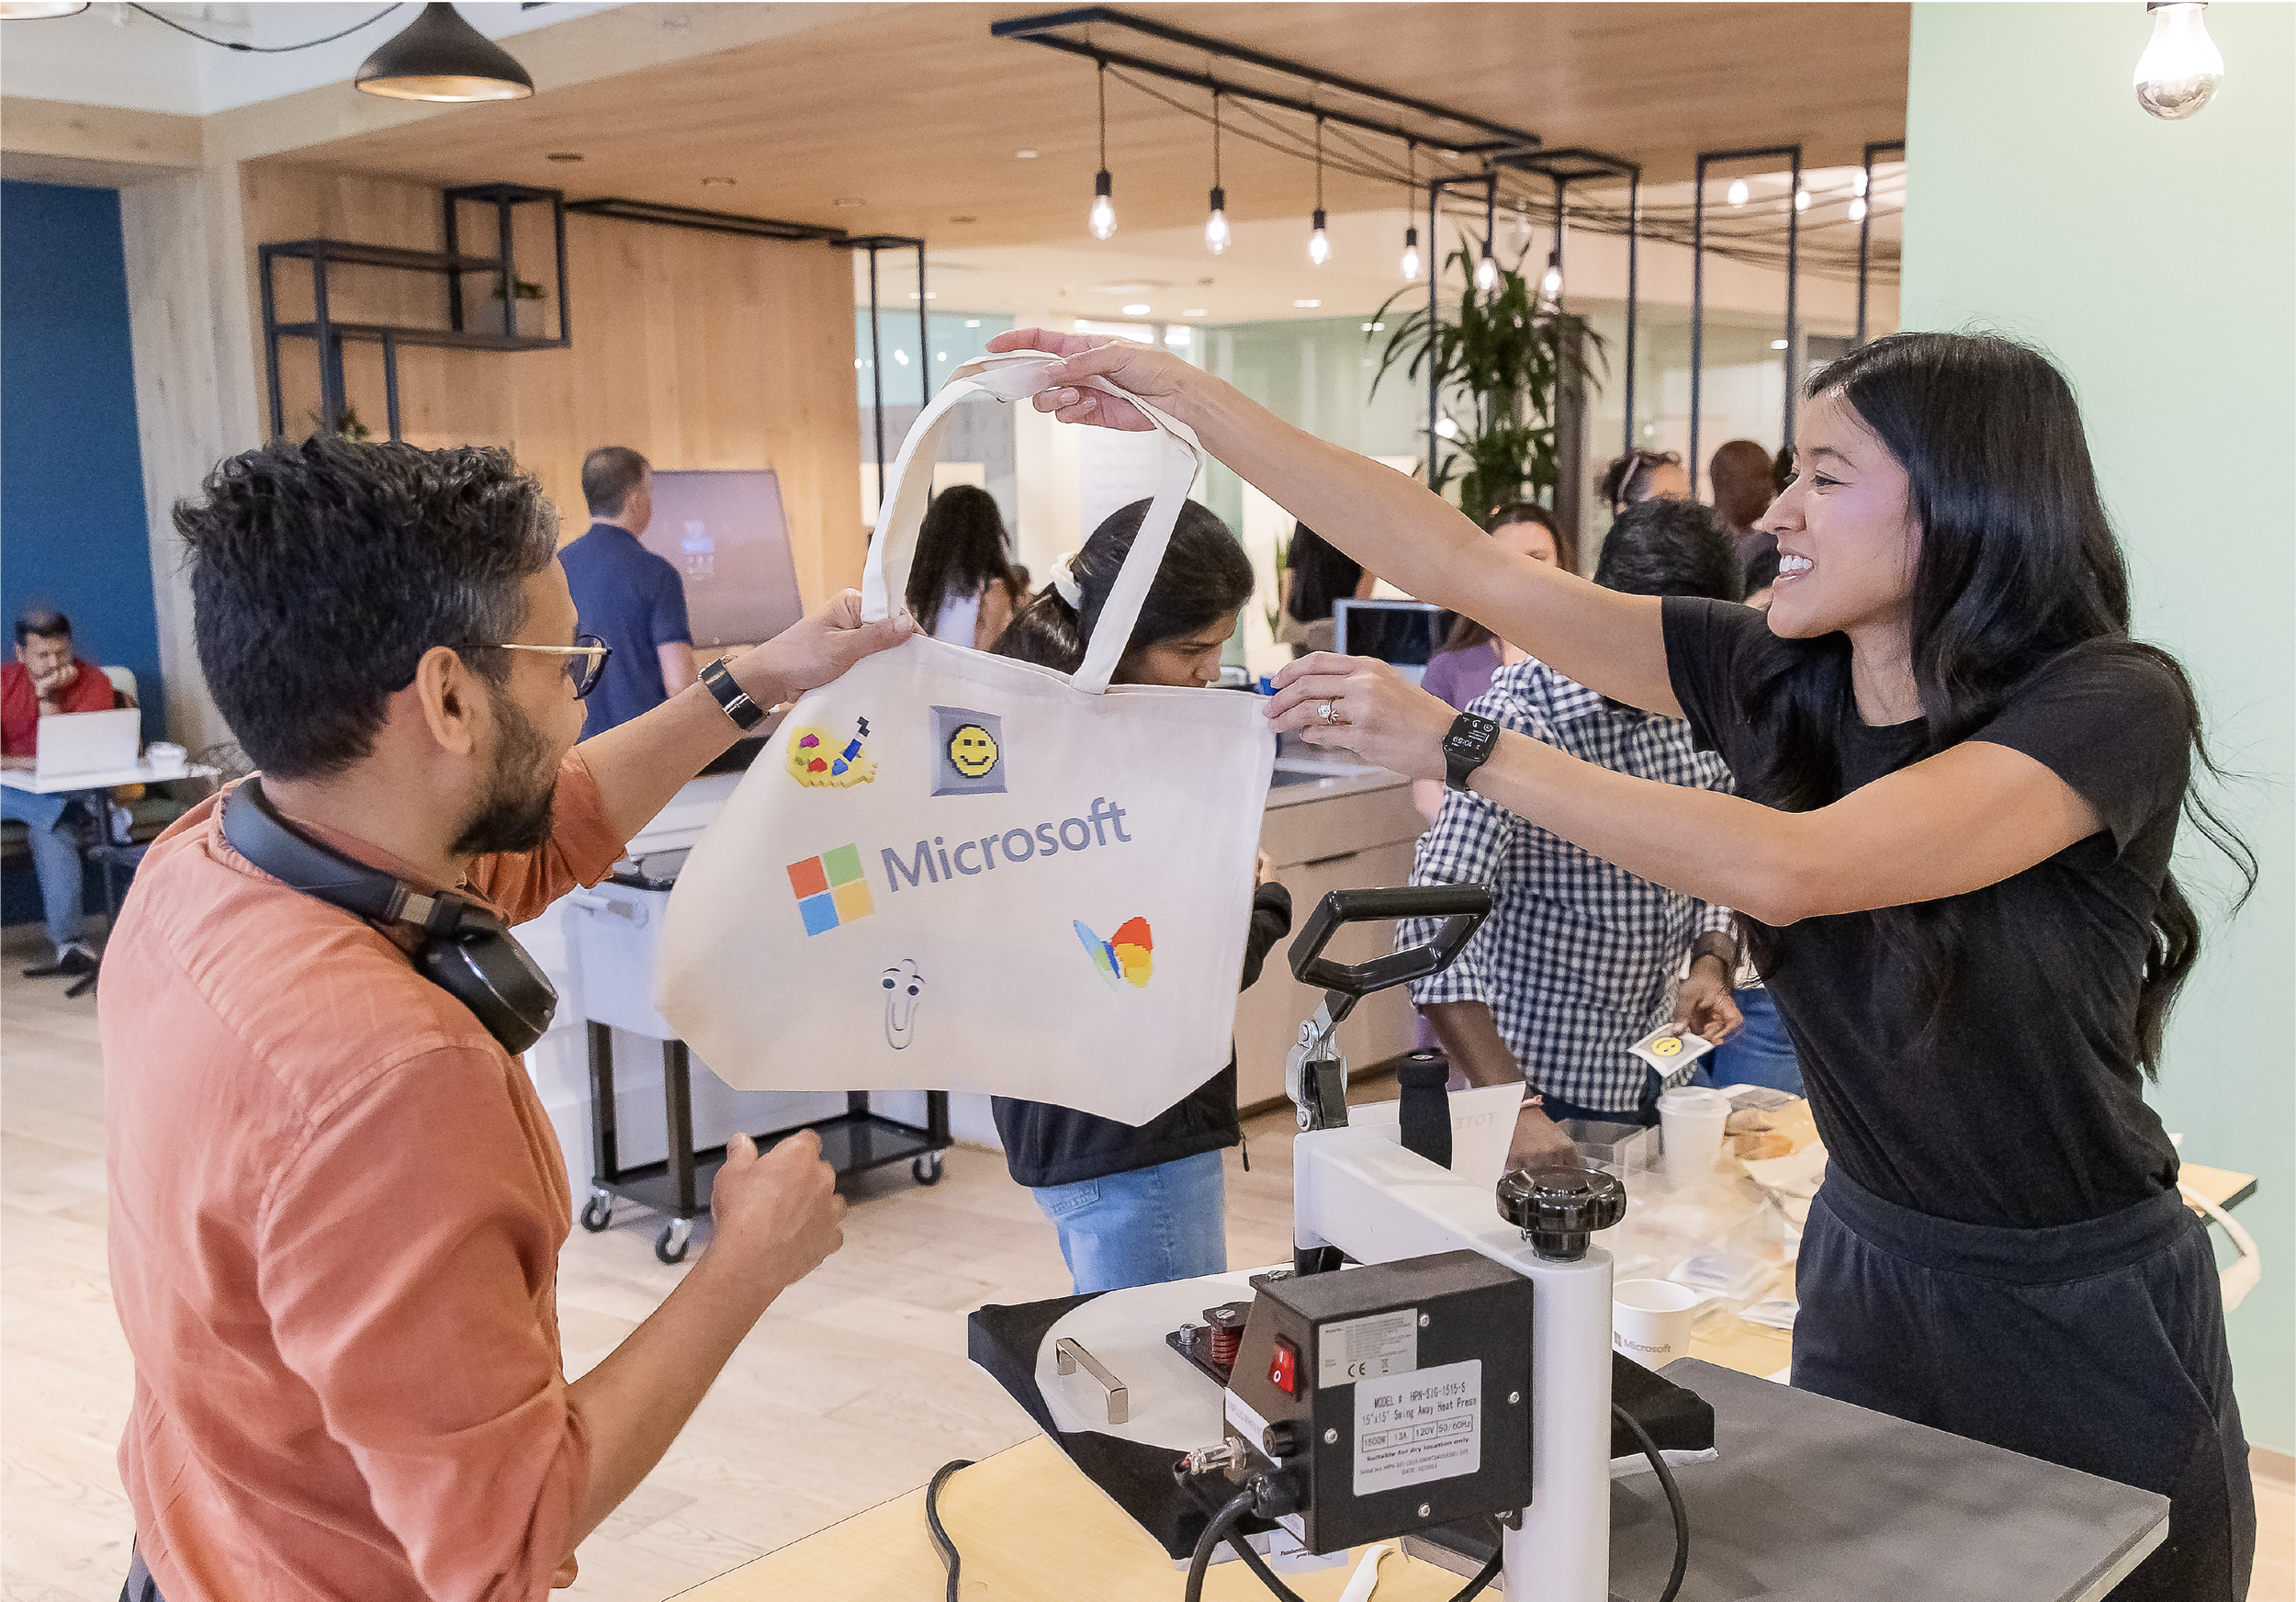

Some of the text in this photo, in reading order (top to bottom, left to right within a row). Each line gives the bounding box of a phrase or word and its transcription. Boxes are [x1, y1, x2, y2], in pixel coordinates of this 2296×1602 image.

[1452, 736, 1473, 748] 10:59
[880, 796, 1131, 893] Microsoft
[1624, 1338, 1671, 1353] Microsoft
[1374, 1395, 1395, 1408] MODEL
[1394, 1408, 1414, 1420] Swing
[1418, 1405, 1434, 1416] Away
[1437, 1401, 1453, 1413] Heat
[1457, 1396, 1477, 1408] Press
[1415, 1426, 1435, 1437] 120V
[1410, 1445, 1423, 1453] dry
[1453, 1437, 1469, 1445] only
